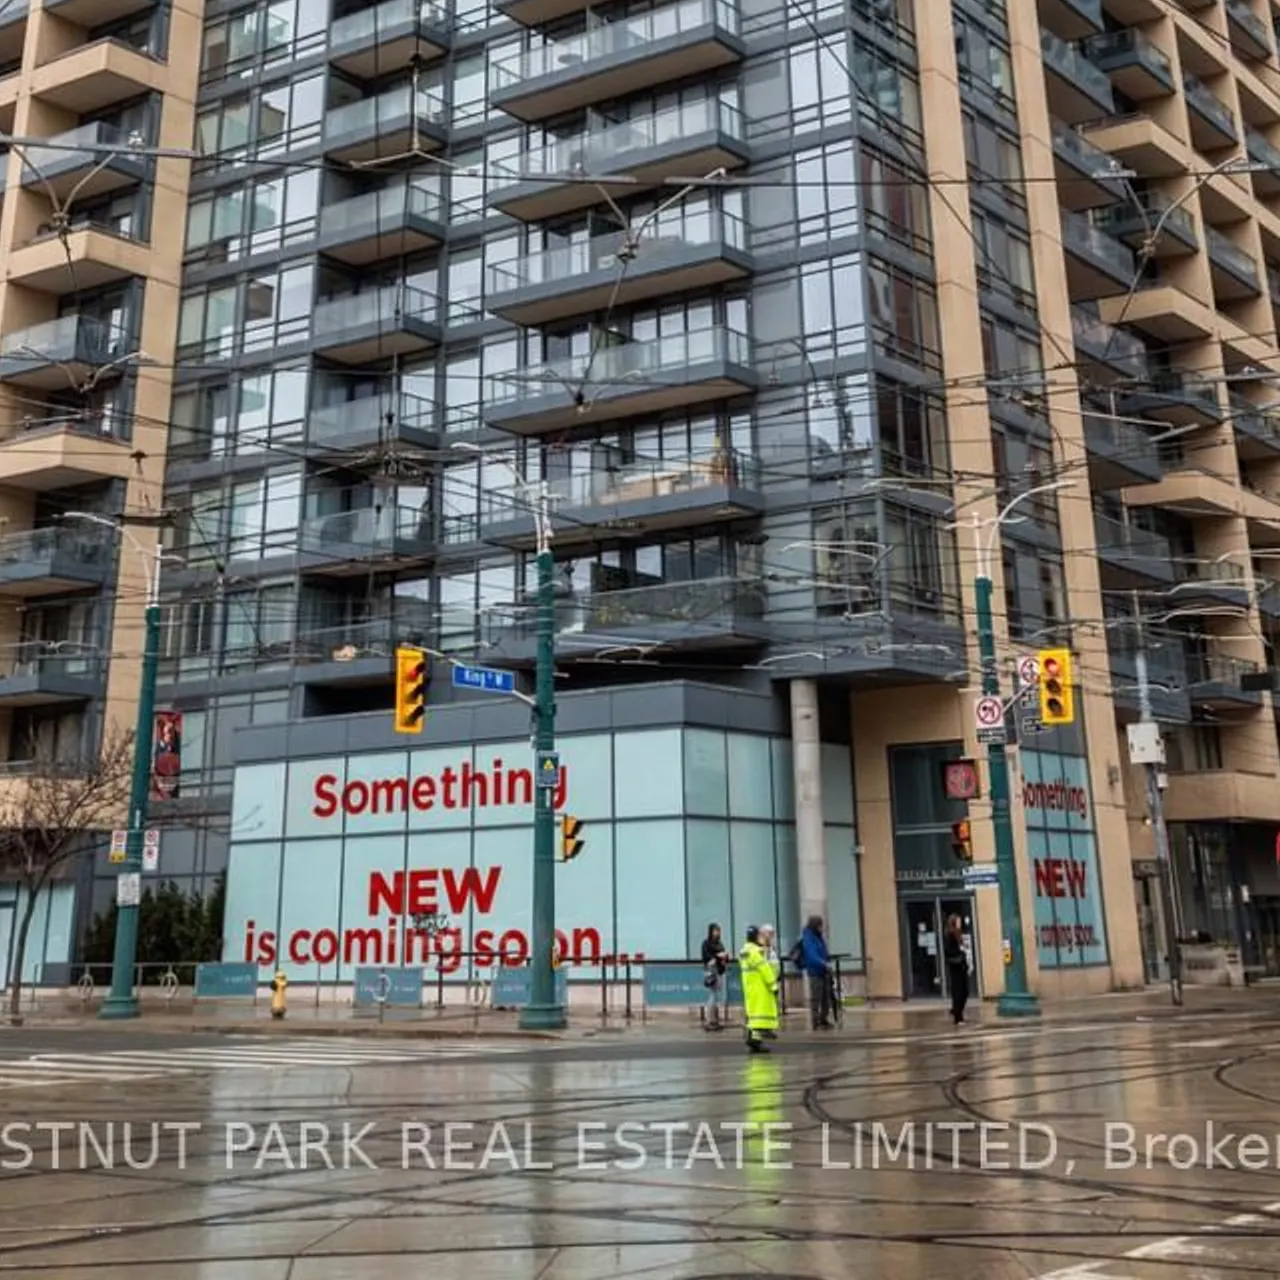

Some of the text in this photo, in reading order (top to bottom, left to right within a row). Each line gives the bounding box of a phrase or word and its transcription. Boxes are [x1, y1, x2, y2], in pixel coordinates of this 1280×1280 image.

[367, 867, 503, 916] NEW
[1034, 858, 1086, 899] NEW
[243, 920, 276, 965] is
[288, 917, 463, 974] coming
